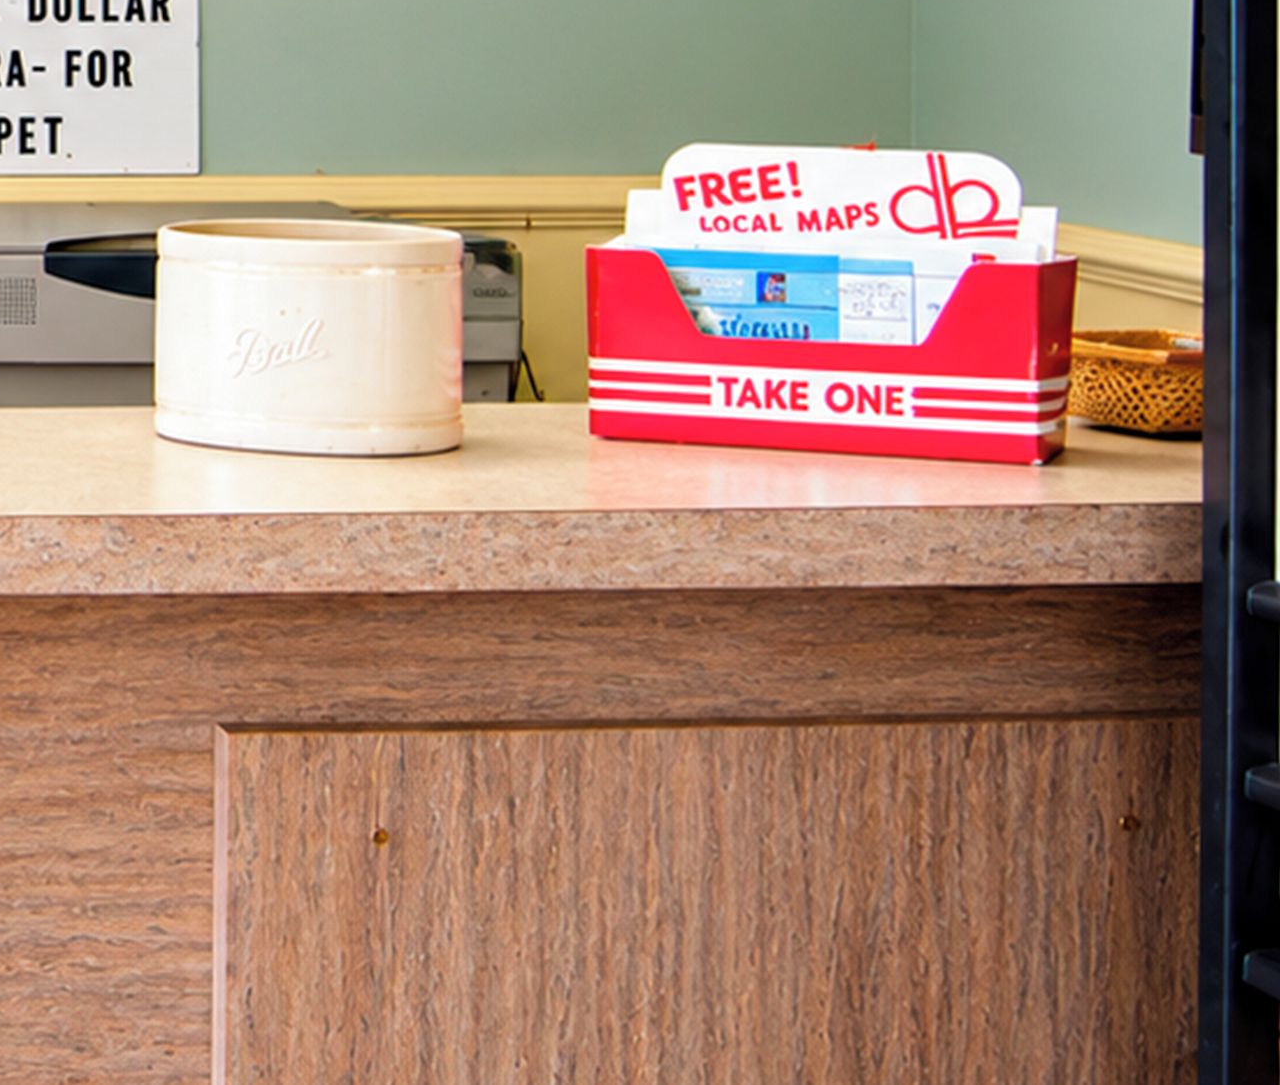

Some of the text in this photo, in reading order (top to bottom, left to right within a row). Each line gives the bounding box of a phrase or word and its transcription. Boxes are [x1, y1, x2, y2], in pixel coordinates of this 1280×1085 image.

[66, 50, 132, 87] FOR
[673, 161, 802, 212] FREE!
[700, 203, 879, 232] LOCAL MAPS
[717, 377, 904, 416] TAKE ONE
